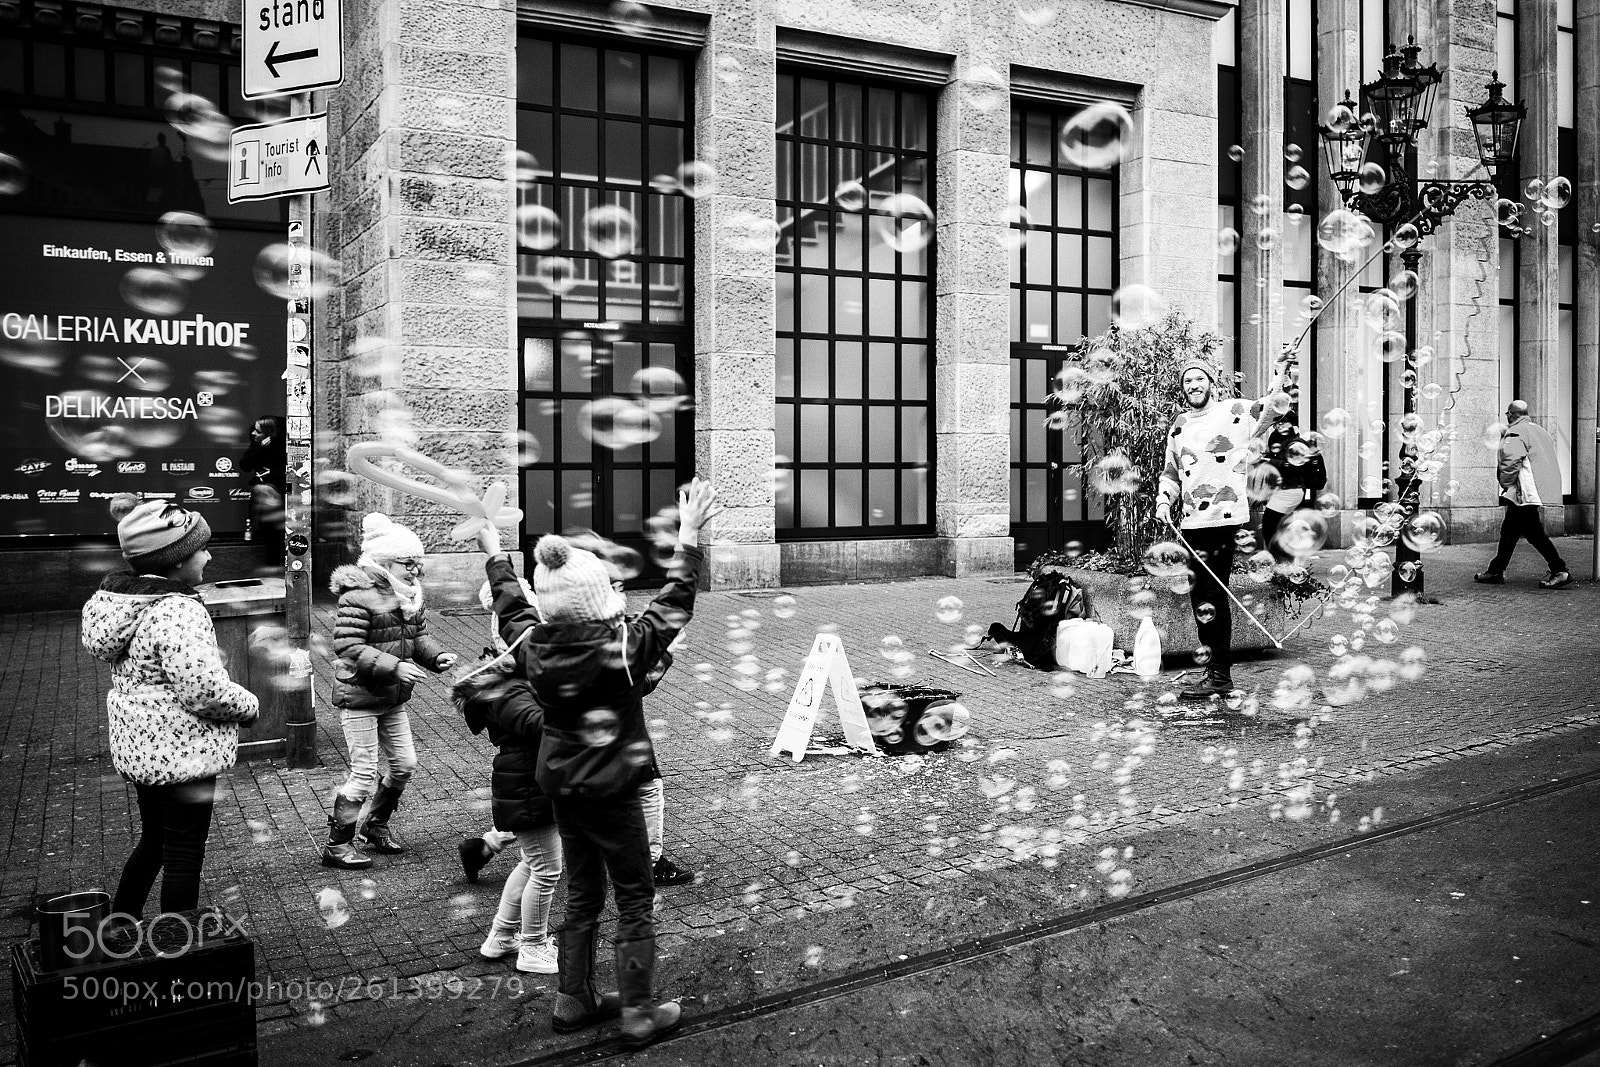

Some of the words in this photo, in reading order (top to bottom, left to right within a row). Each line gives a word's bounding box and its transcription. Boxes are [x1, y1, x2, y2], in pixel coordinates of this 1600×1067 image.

[259, 0, 325, 31] stand
[265, 138, 300, 158] Tourist
[265, 162, 283, 178] Info
[43, 244, 112, 262] Einkaufen,
[115, 248, 153, 263] Essen
[155, 252, 167, 264] &
[168, 252, 215, 267] Trinken
[2, 312, 120, 343] GALERIA
[45, 395, 199, 420] DELIKATESSA
